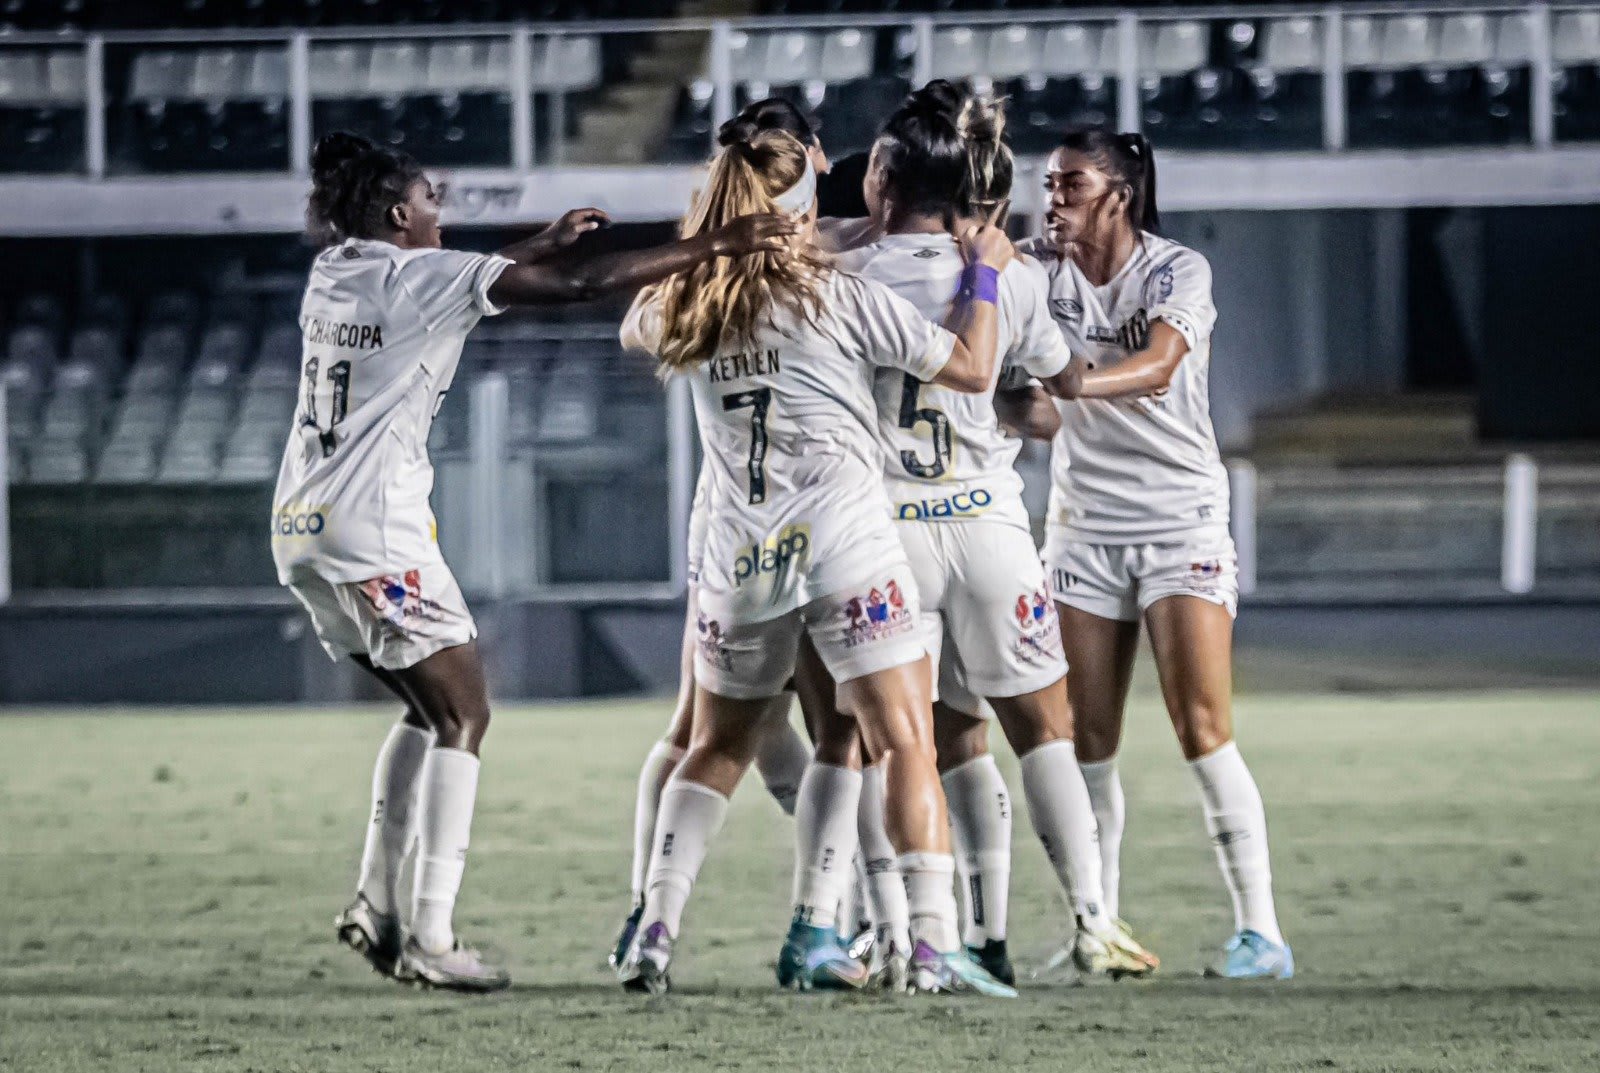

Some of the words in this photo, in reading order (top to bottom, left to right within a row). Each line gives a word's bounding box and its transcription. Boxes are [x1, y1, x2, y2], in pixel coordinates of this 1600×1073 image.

[300, 356, 352, 458] 11
[709, 349, 781, 384] KETLEN
[722, 387, 772, 506] 7
[898, 371, 952, 479] 5
